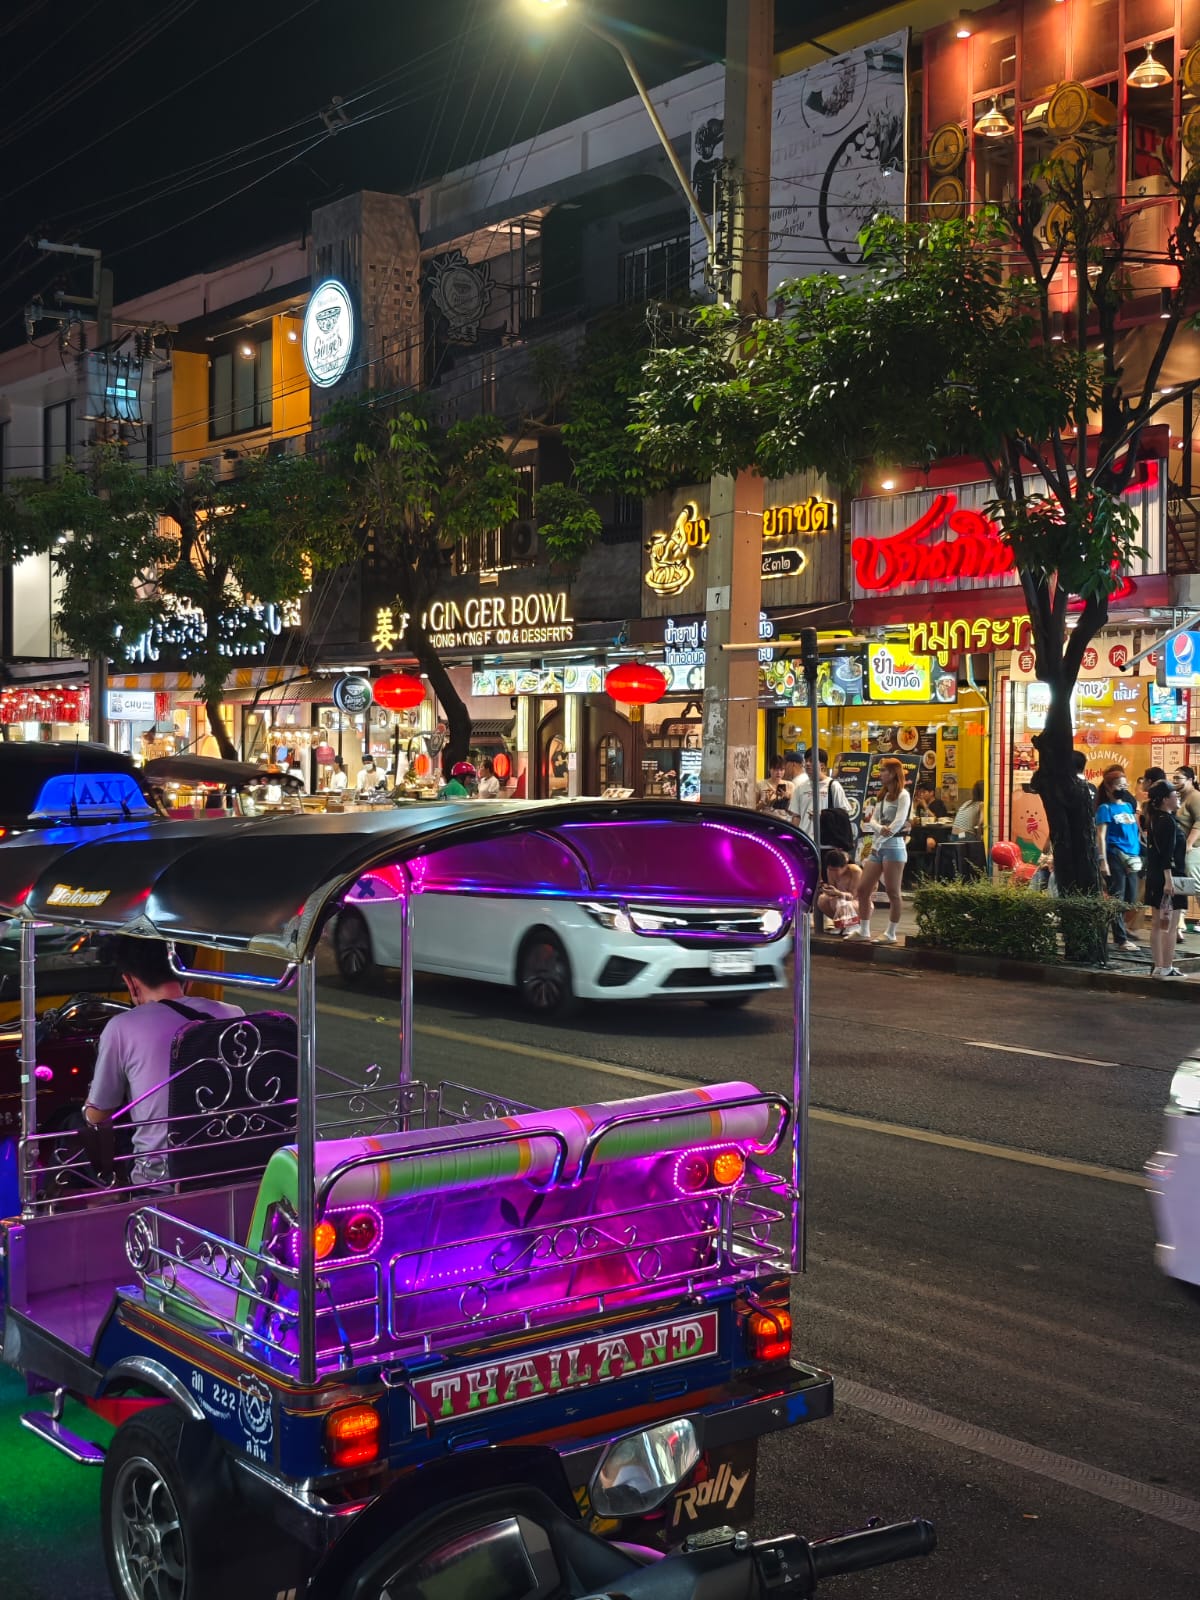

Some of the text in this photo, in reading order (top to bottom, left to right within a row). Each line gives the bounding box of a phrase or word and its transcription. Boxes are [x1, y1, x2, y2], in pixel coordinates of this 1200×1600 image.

[430, 592, 574, 631] GINGER BOWL
[714, 592, 721, 605] 7
[484, 630, 511, 645] FOD
[511, 629, 520, 644] &
[124, 700, 142, 709] CHU
[431, 1322, 704, 1416] THAILAND
[213, 1383, 236, 1411] 222
[672, 1461, 750, 1527] Rally
